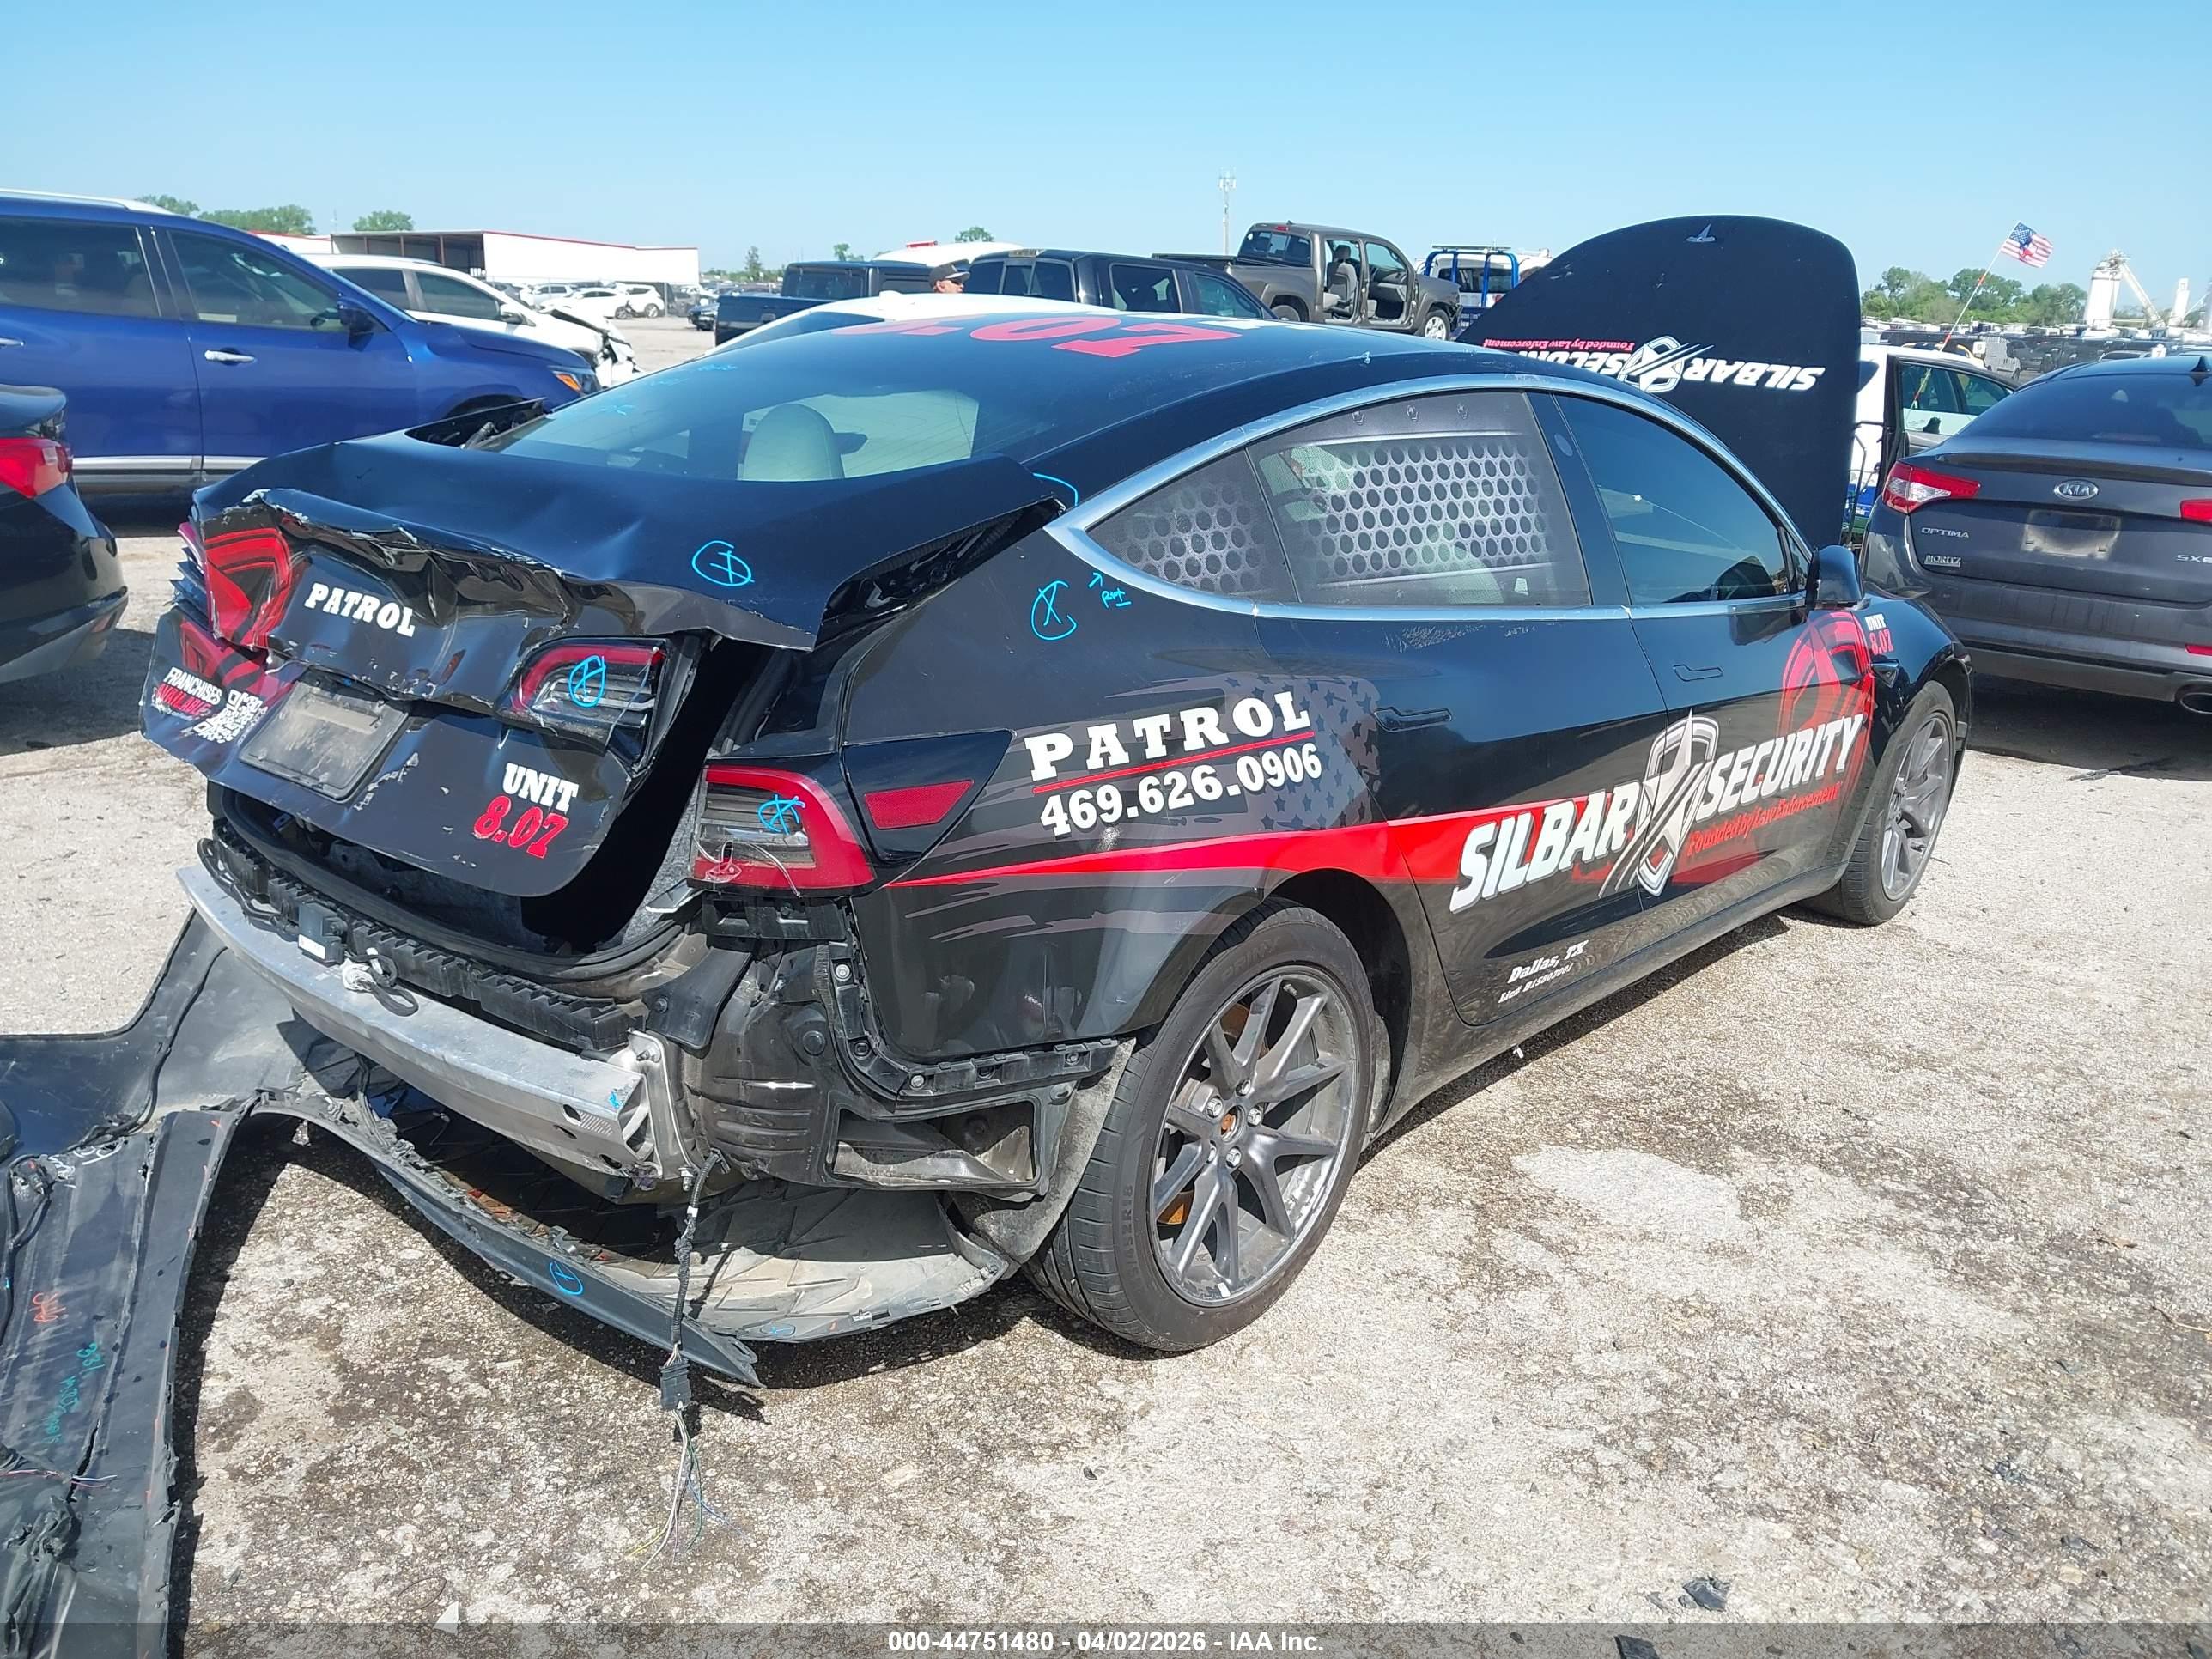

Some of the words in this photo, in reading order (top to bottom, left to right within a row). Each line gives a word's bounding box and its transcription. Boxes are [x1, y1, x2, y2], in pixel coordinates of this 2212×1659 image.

[1483, 338, 1549, 349] Enforcement
[1549, 340, 1571, 349] Law
[1587, 342, 1635, 352] Founded
[1681, 356, 1826, 392] SILBAR
[1921, 526, 1970, 538] OPTIMA
[1924, 555, 1961, 566] MORITZ
[303, 582, 416, 638] PATROL
[1864, 613, 1887, 631] UNIT
[1869, 629, 1894, 655] 8.07
[163, 666, 222, 706] FRANCHISES
[1024, 690, 1311, 781] PATROL
[502, 762, 580, 815] UNIT
[1040, 742, 1322, 837] 469.626.0906
[473, 795, 569, 859] 8.07
[1449, 781, 1641, 914] SILBAR
[1695, 714, 1864, 823] SECURITY
[1507, 955, 1560, 984] Dallas,
[1564, 939, 1589, 961] TX
